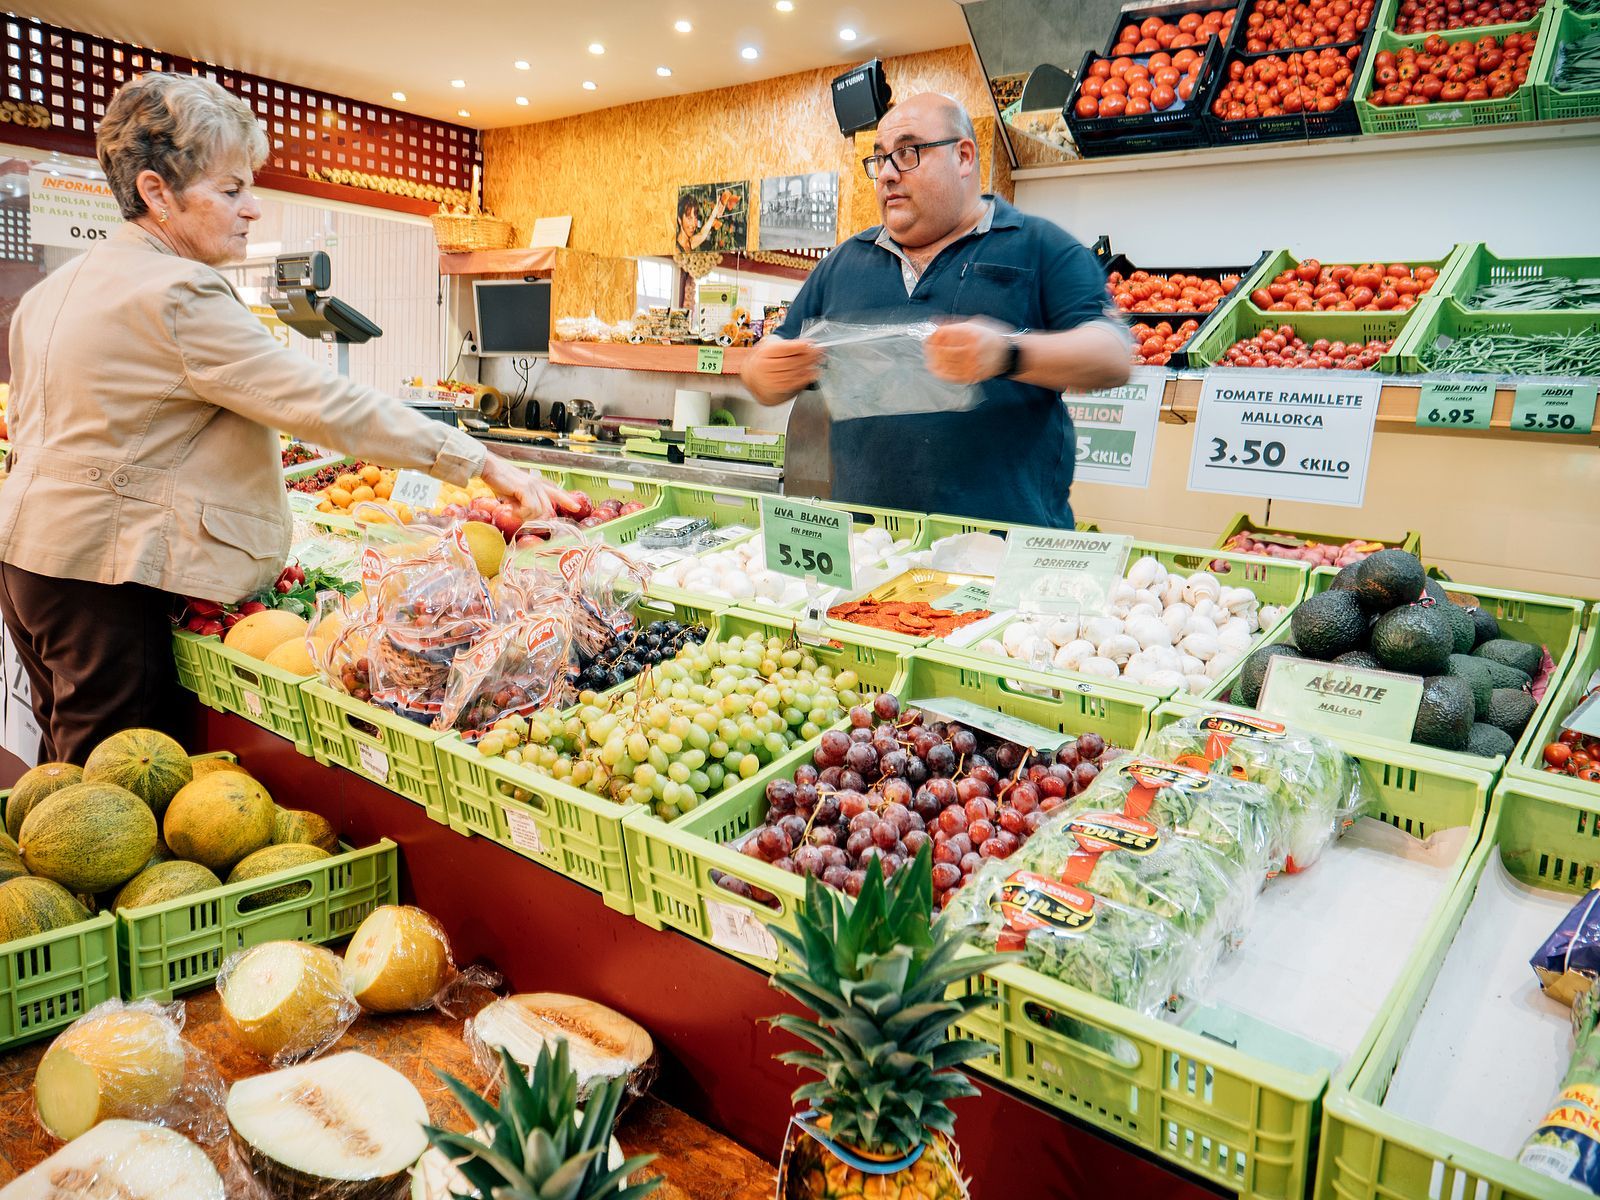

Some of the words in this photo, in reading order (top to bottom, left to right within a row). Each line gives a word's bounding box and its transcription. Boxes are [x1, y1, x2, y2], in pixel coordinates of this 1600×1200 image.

[836, 80, 845, 91] SU
[845, 71, 865, 88] TURNO
[32, 191, 51, 200] LAS
[54, 195, 91, 207] BOLSAS
[32, 205, 46, 214] DE
[49, 207, 74, 217] ASAS
[79, 211, 88, 220] SE
[70, 226, 107, 241] 0.05
[700, 361, 717, 371] 2.95
[1432, 384, 1461, 392] JUDIA
[1463, 385, 1488, 393] FINA
[1542, 388, 1574, 396] JUDIA
[1215, 389, 1274, 402] TOMATE
[1278, 392, 1363, 407] RAMILLETE
[1241, 411, 1324, 427] MALLORCA
[1428, 408, 1475, 424] 6.95
[1524, 413, 1575, 430] 5.50
[1209, 437, 1286, 467] 3.50
[1300, 457, 1350, 473] €KILO
[400, 481, 429, 500] 4.95
[774, 507, 794, 518] UVA
[800, 512, 839, 527] BLANCA
[801, 529, 823, 539] PEPITA
[1025, 536, 1112, 552] CHAMPINON
[778, 543, 834, 575] 5.50
[1034, 557, 1090, 569] PORRERES
[1306, 675, 1389, 701] AGUATE
[1318, 702, 1363, 718] MALAGA
[1083, 827, 1151, 848] DULZE
[1016, 874, 1085, 906] COZONES
[1012, 891, 1085, 927] DULZE
